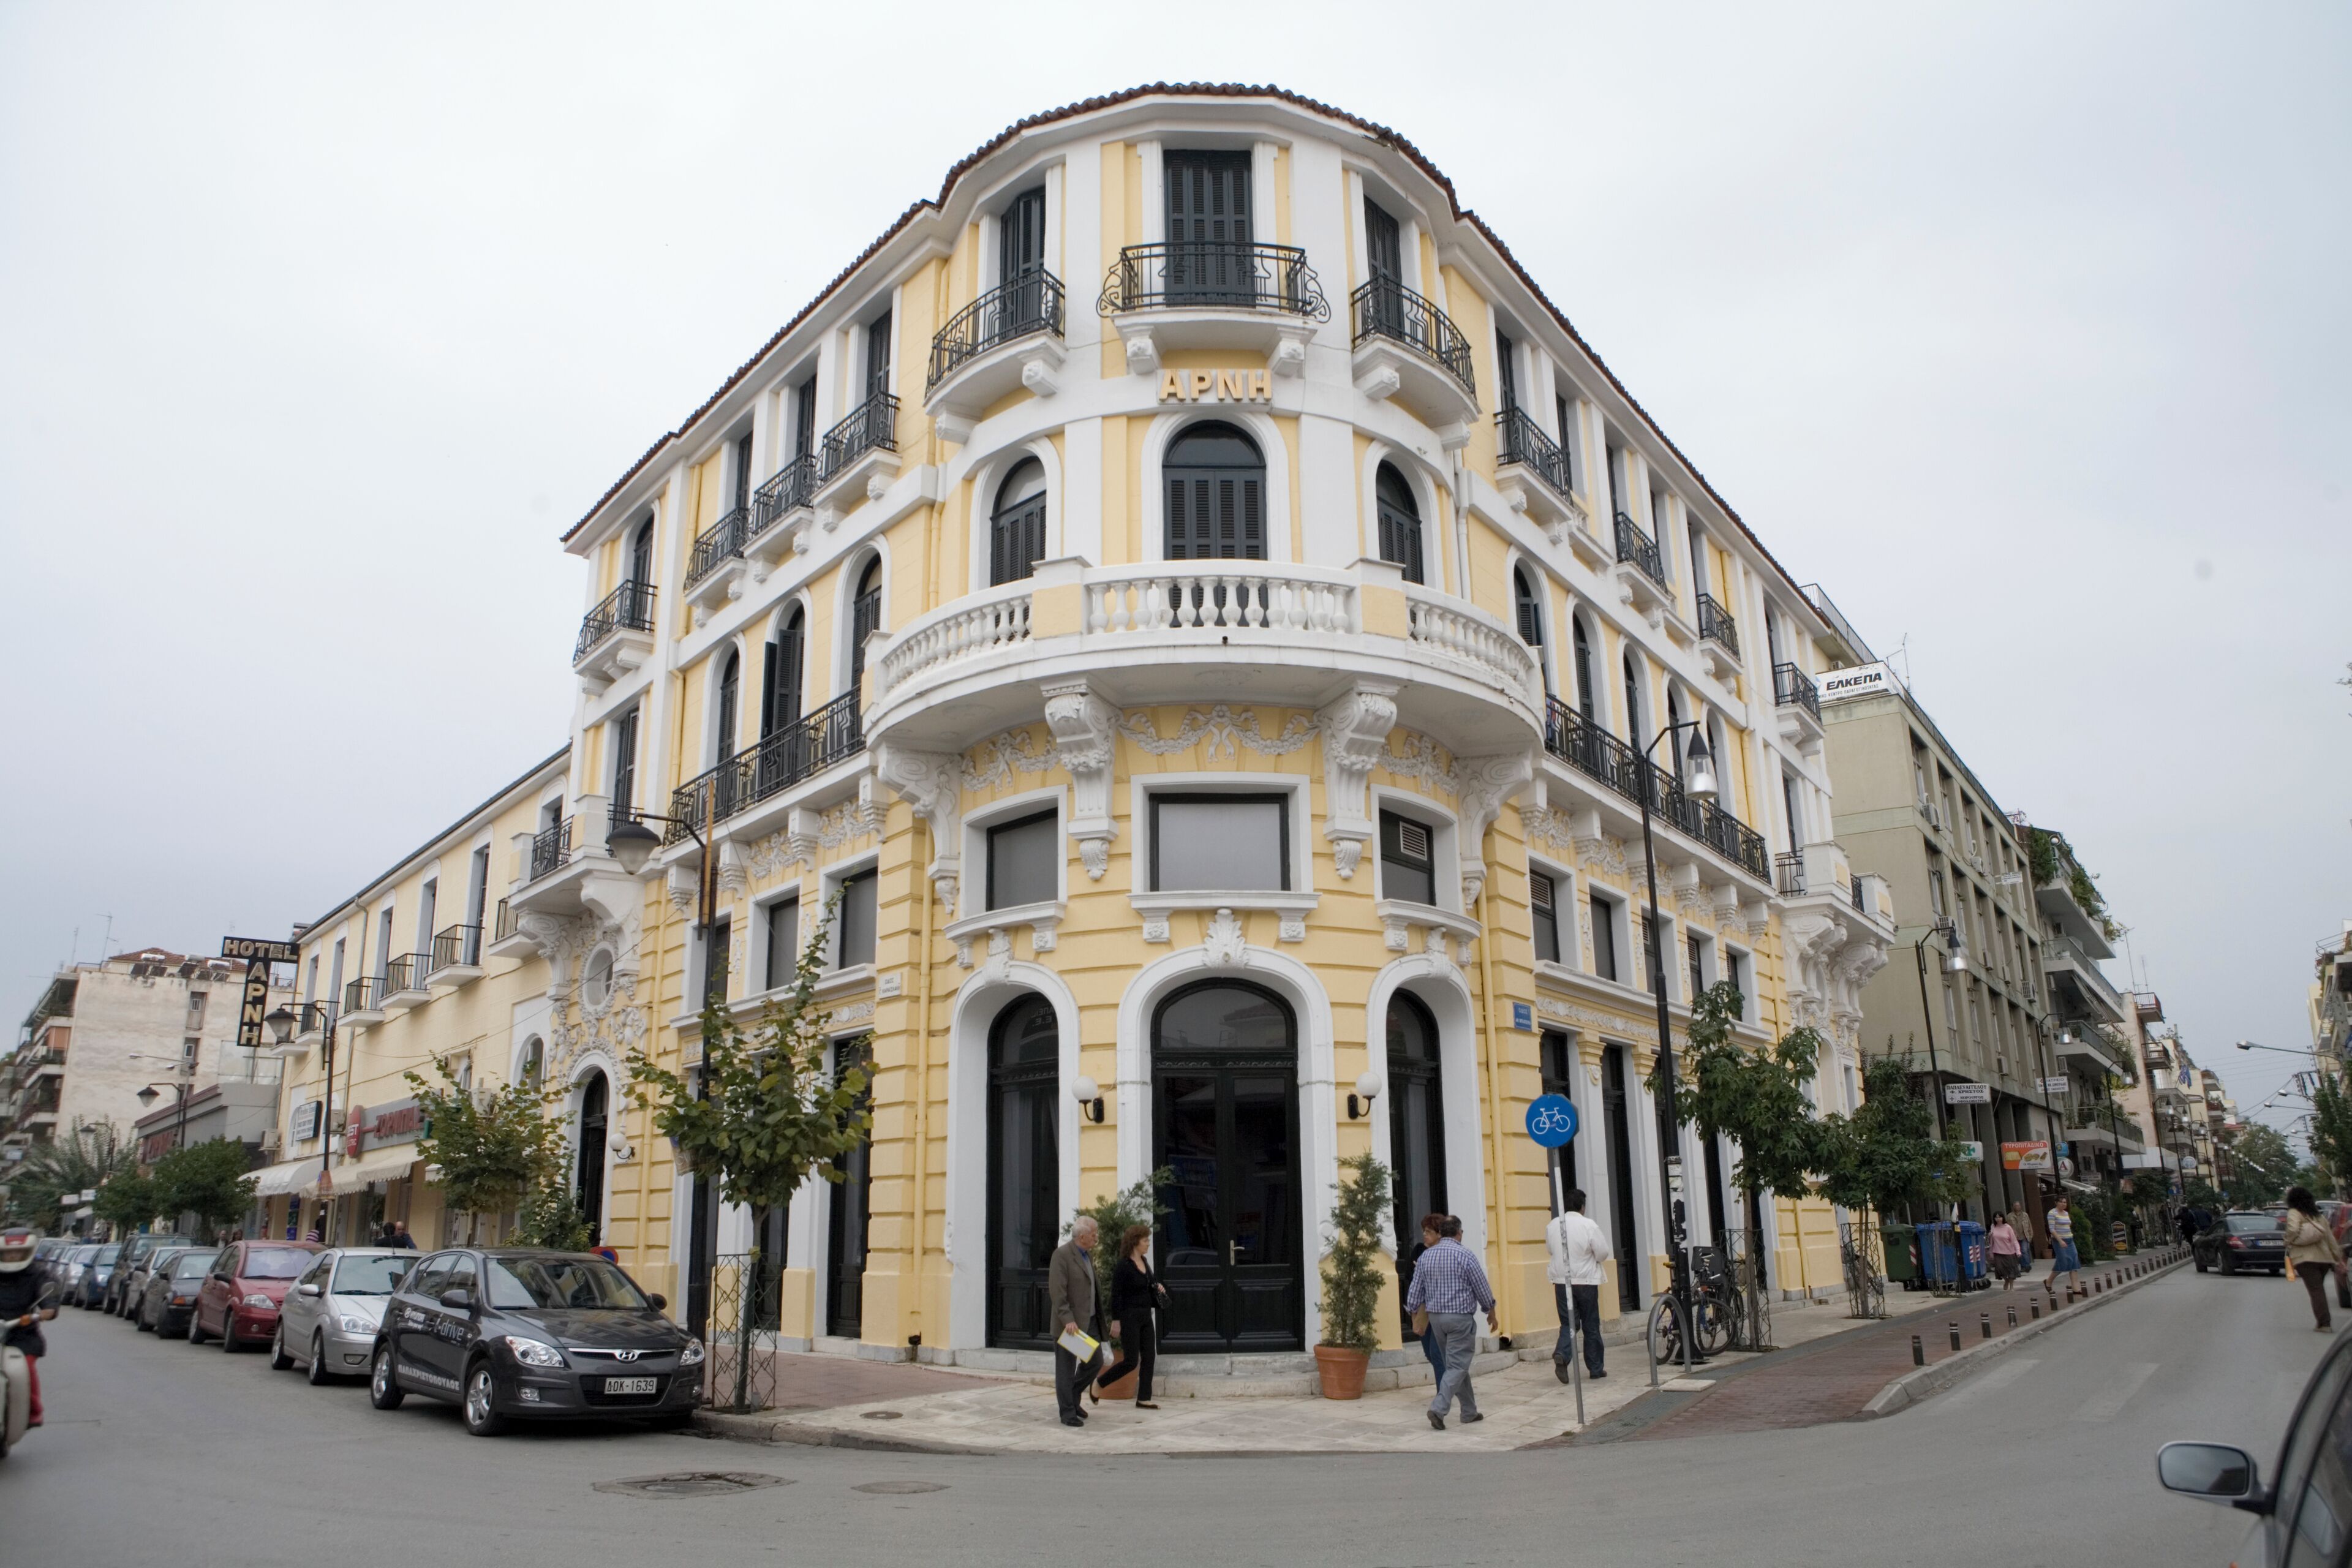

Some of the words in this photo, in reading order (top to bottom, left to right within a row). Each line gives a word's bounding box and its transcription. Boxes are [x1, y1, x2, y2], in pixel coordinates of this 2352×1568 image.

[1159, 369, 1272, 401] ΑΡΝΗ
[1826, 673, 1882, 691] ΕΛΚΕΠΑ
[223, 939, 298, 960] HOTEL
[239, 962, 268, 1046] ΑΡΝΗ
[398, 1364, 460, 1390] ΠΑΠΑΧΡΙΣΤΟΠΟΥΛΟΣ
